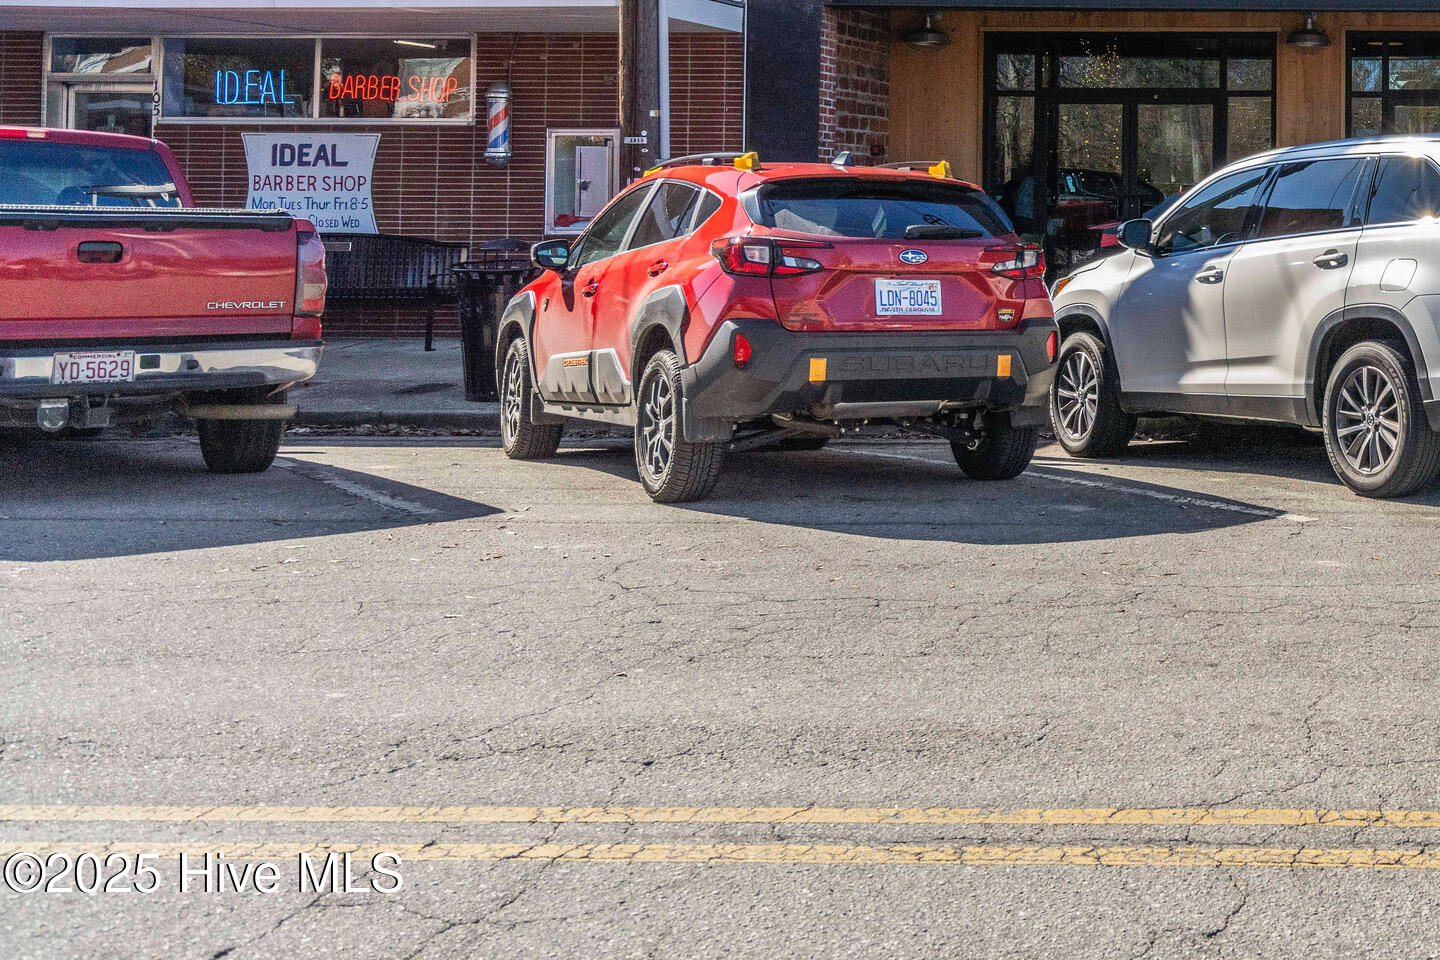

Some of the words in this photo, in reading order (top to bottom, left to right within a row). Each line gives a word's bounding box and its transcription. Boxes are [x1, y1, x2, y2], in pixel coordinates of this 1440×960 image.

[216, 69, 295, 105] IDEAL
[329, 74, 400, 101] BARBER
[408, 75, 458, 102] SHOP
[152, 80, 161, 116] 105
[271, 143, 349, 167] IDEAL
[253, 174, 317, 191] BARBER
[322, 175, 367, 191] SHOP
[350, 197, 368, 210] 8-5
[207, 301, 287, 309] CHEVROLET
[59, 360, 130, 380] YD-5629
[841, 353, 989, 373] SUBARU
